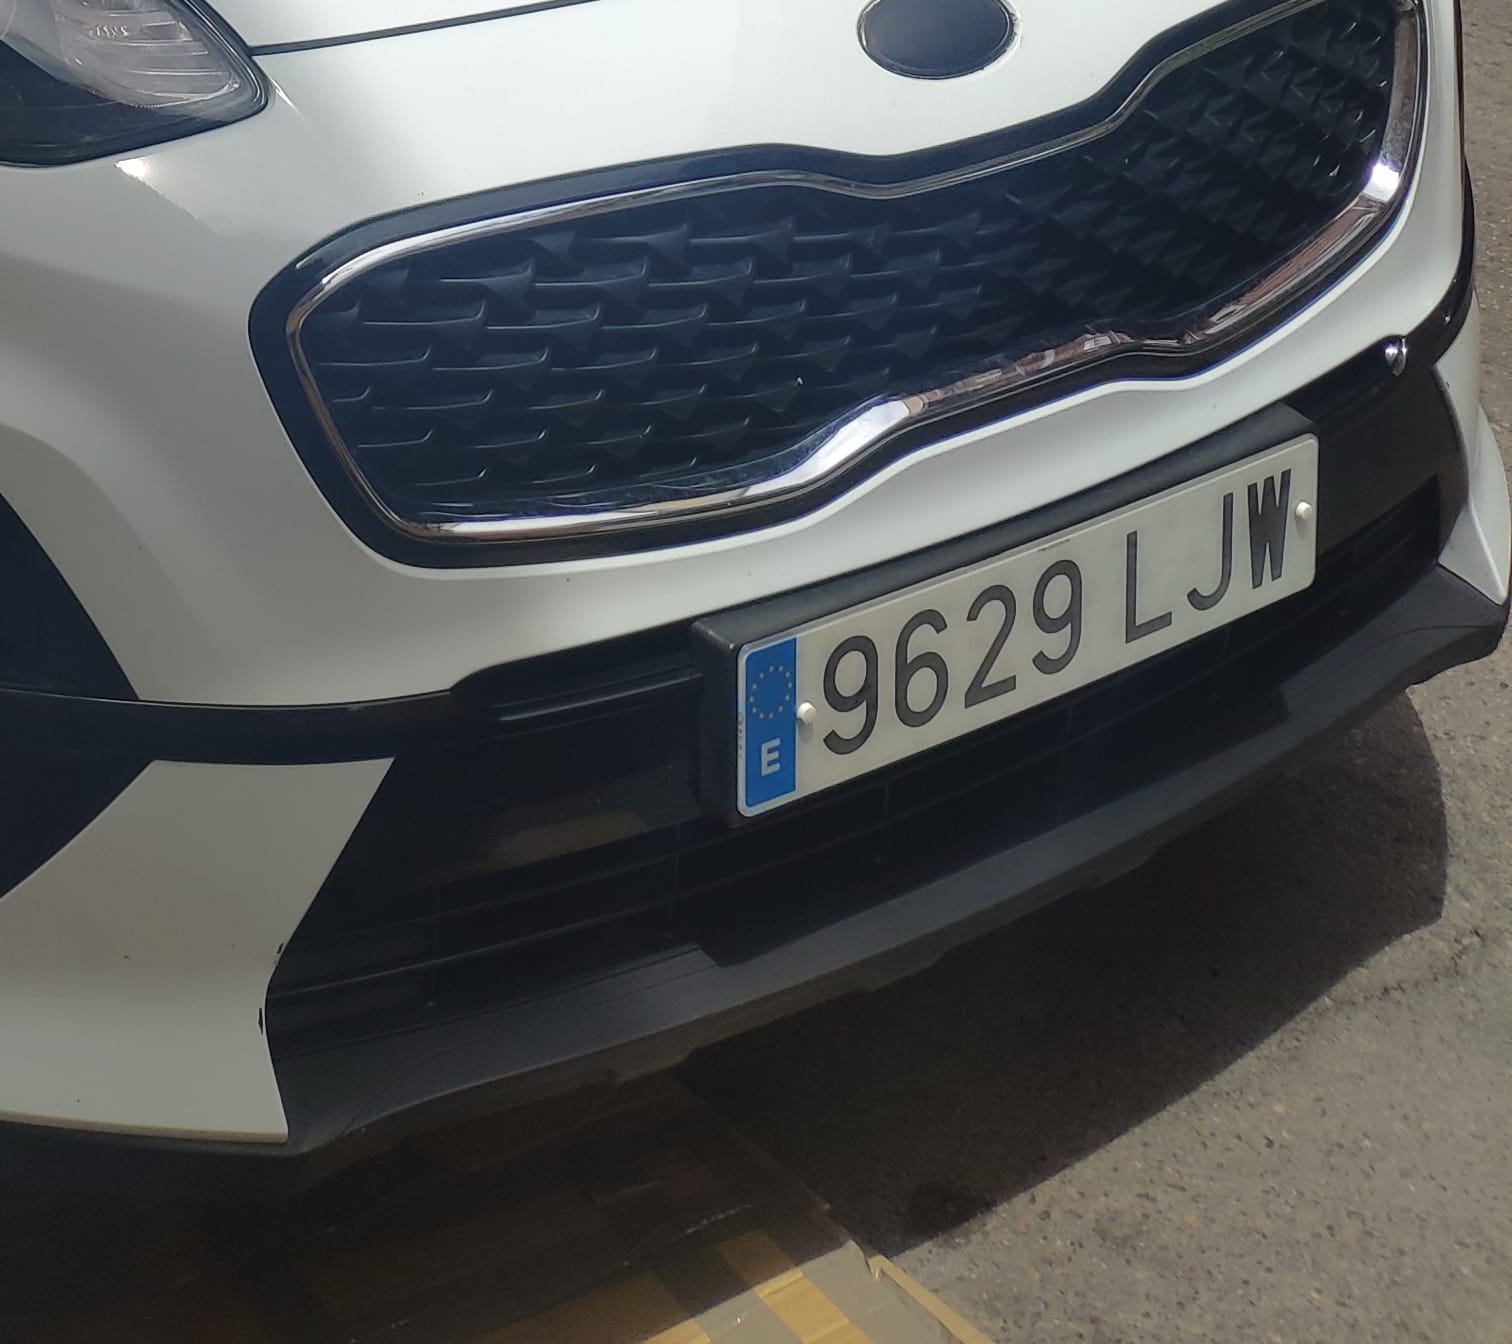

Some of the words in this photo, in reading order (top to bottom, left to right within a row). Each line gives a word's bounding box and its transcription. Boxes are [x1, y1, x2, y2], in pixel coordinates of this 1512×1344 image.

[822, 560, 1083, 755] 9629
[1125, 469, 1292, 644] LJW
[760, 738, 781, 777] E
